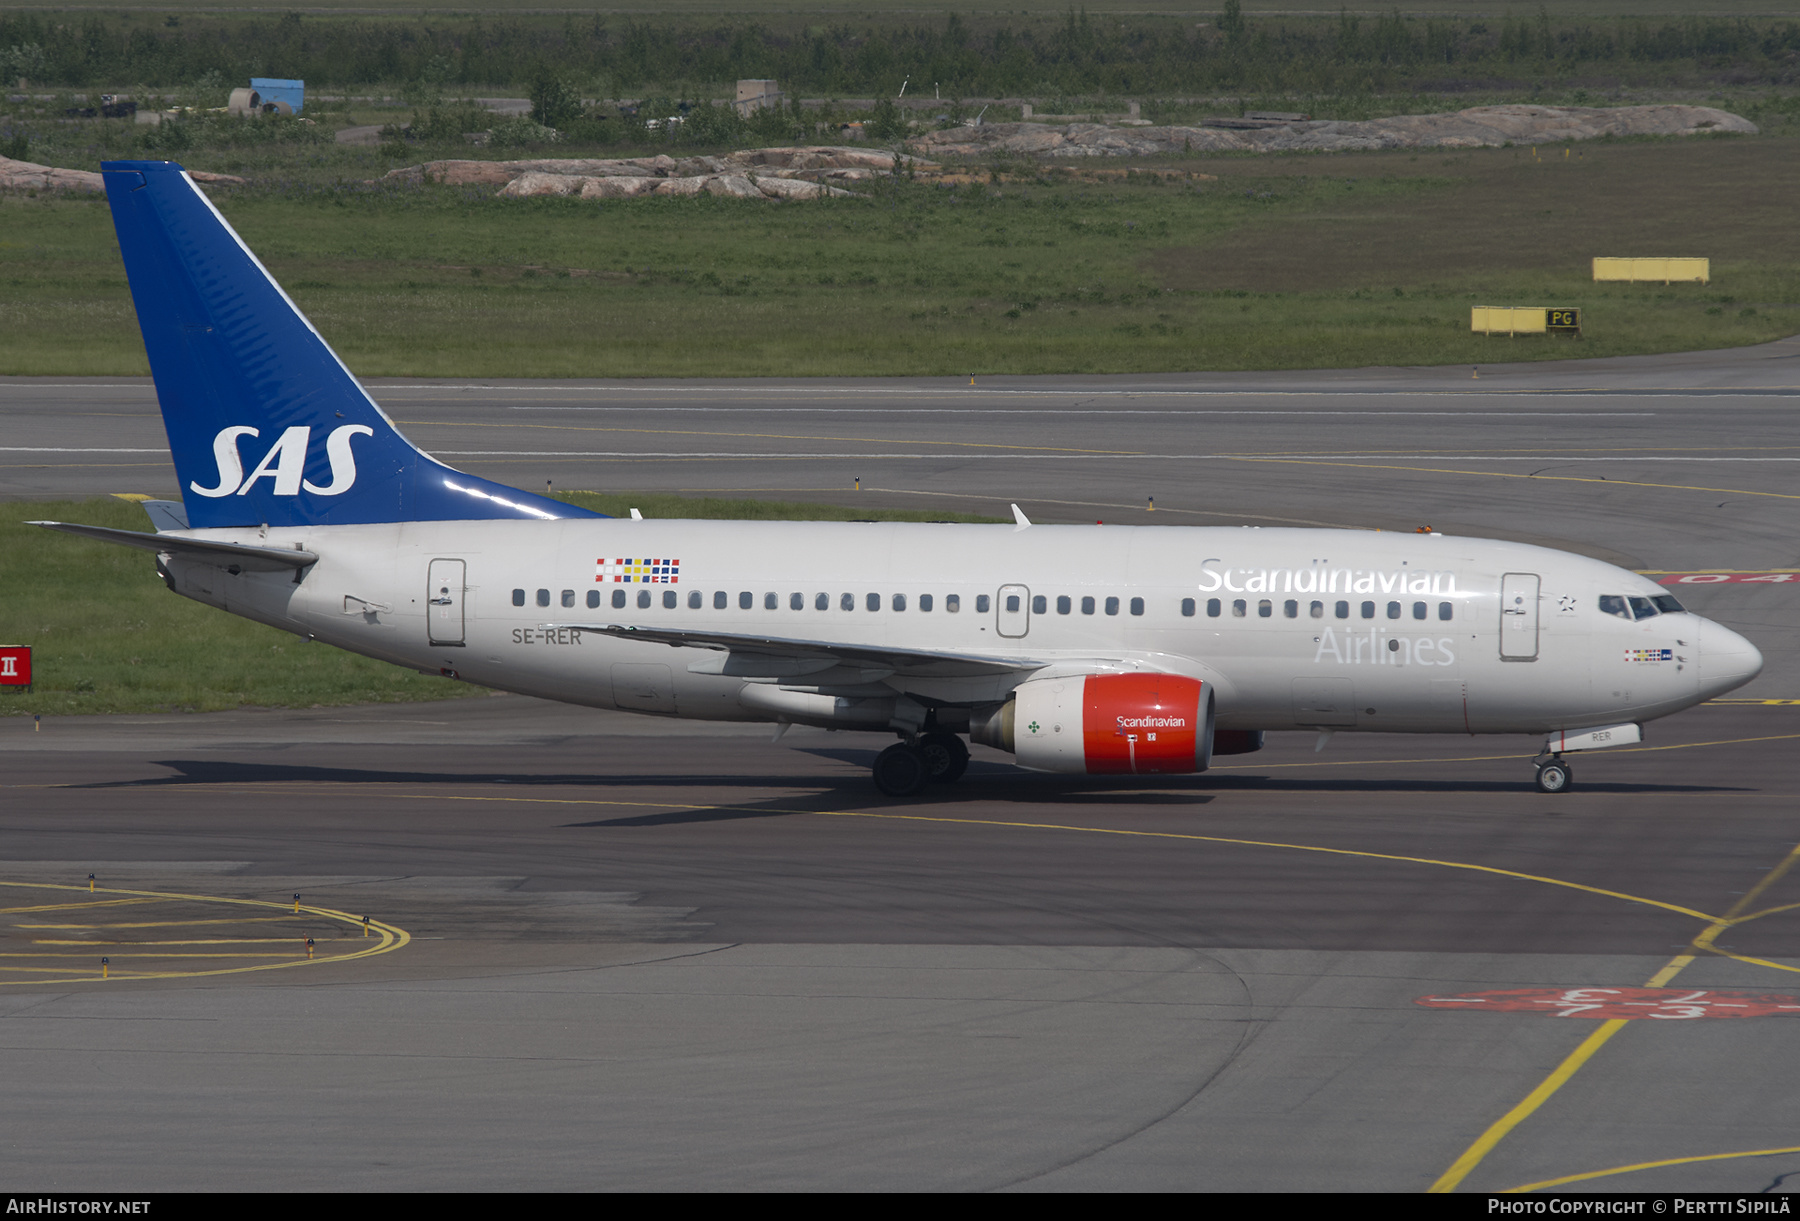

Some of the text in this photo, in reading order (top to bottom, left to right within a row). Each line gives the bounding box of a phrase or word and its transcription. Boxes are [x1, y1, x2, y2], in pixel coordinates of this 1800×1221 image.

[1552, 312, 1573, 325] PG
[190, 424, 374, 498] SAS
[1198, 558, 1456, 594] Scandinavian
[512, 628, 582, 645] SE-RER
[1313, 626, 1455, 666] Airlines
[1116, 715, 1185, 727] Scandinavian
[1592, 731, 1611, 742] RER
